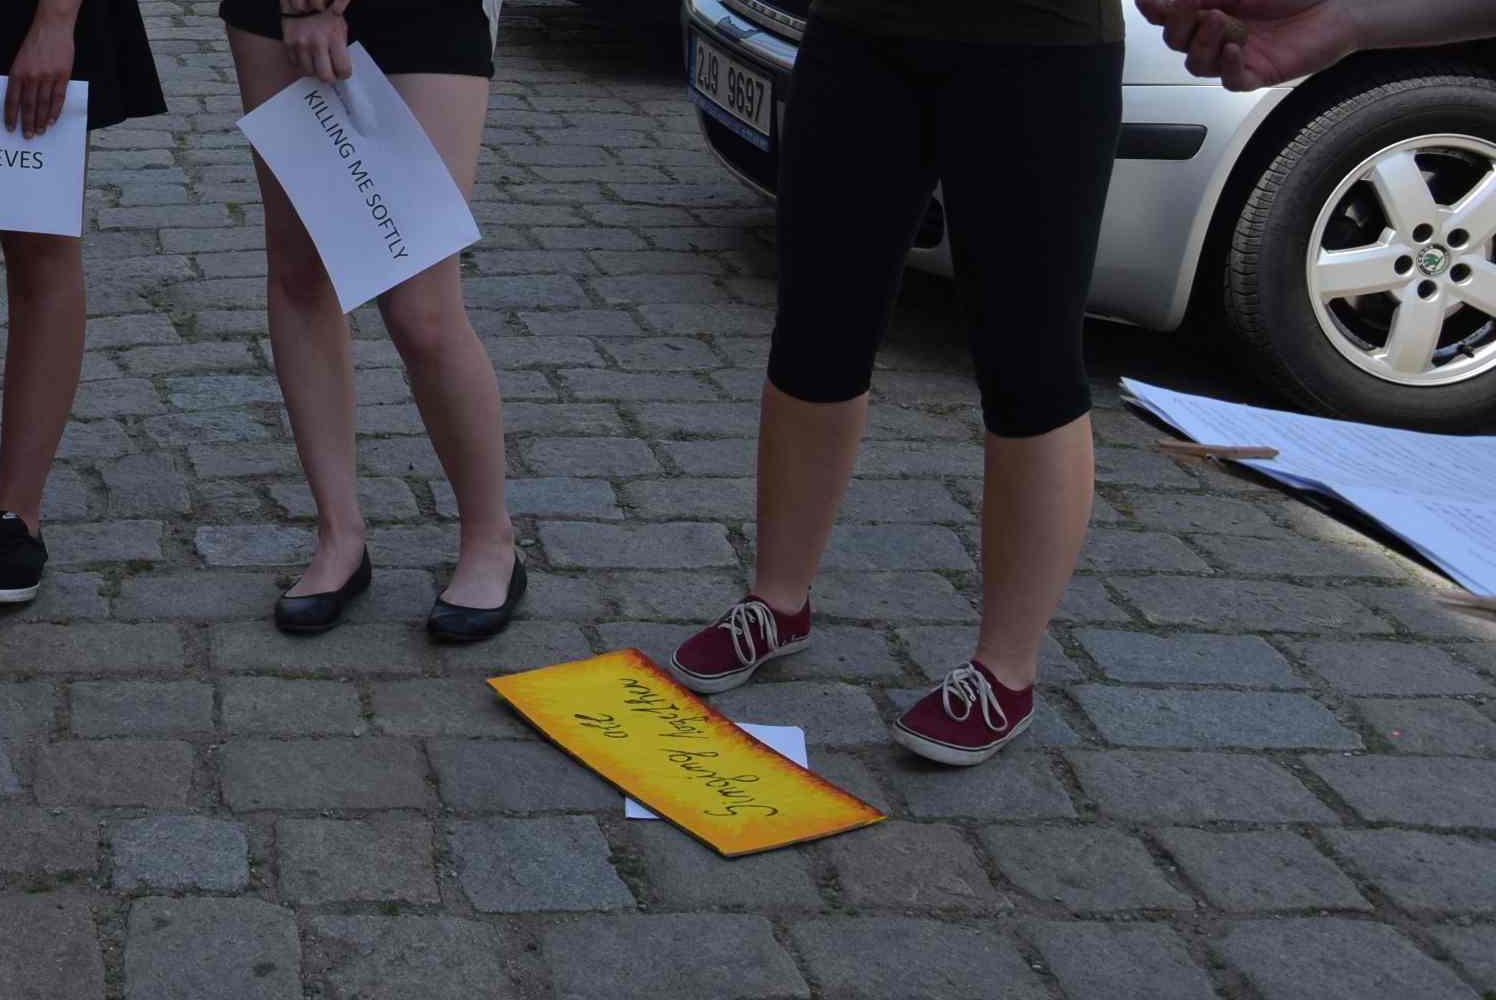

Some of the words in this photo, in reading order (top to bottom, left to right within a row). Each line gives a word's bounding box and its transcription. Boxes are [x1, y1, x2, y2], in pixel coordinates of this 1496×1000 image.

[697, 46, 718, 95] 2J9
[728, 66, 764, 121] 9697
[304, 90, 355, 159] KILLING
[347, 160, 374, 193] ME
[365, 194, 409, 260] SOFTLY
[660, 747, 779, 817] Singing
